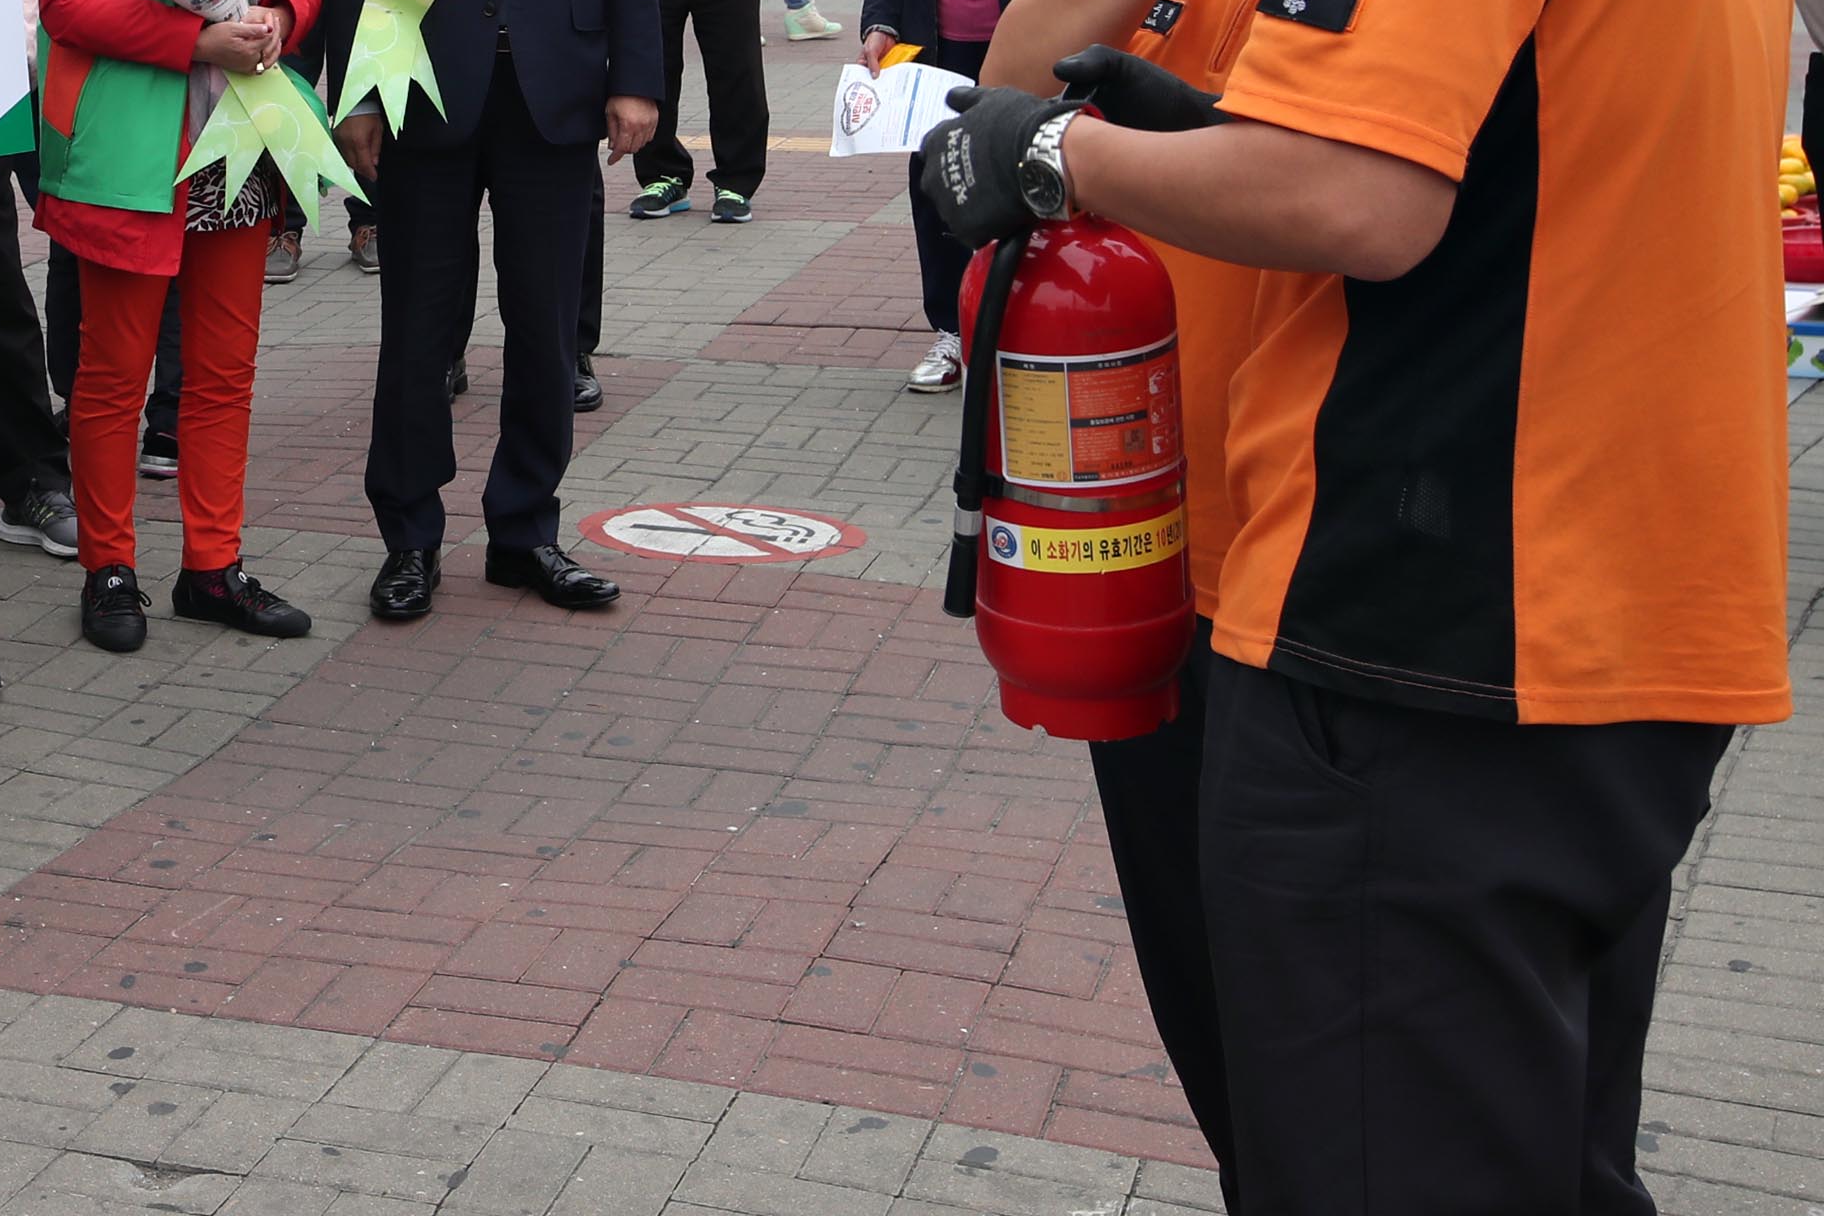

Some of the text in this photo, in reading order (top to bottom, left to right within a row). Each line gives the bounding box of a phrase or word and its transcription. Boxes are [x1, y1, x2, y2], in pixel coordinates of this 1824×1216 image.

[1031, 539, 1042, 560] 이
[1047, 540, 1094, 562] 소화기의
[1099, 532, 1153, 560] 유효기간은
